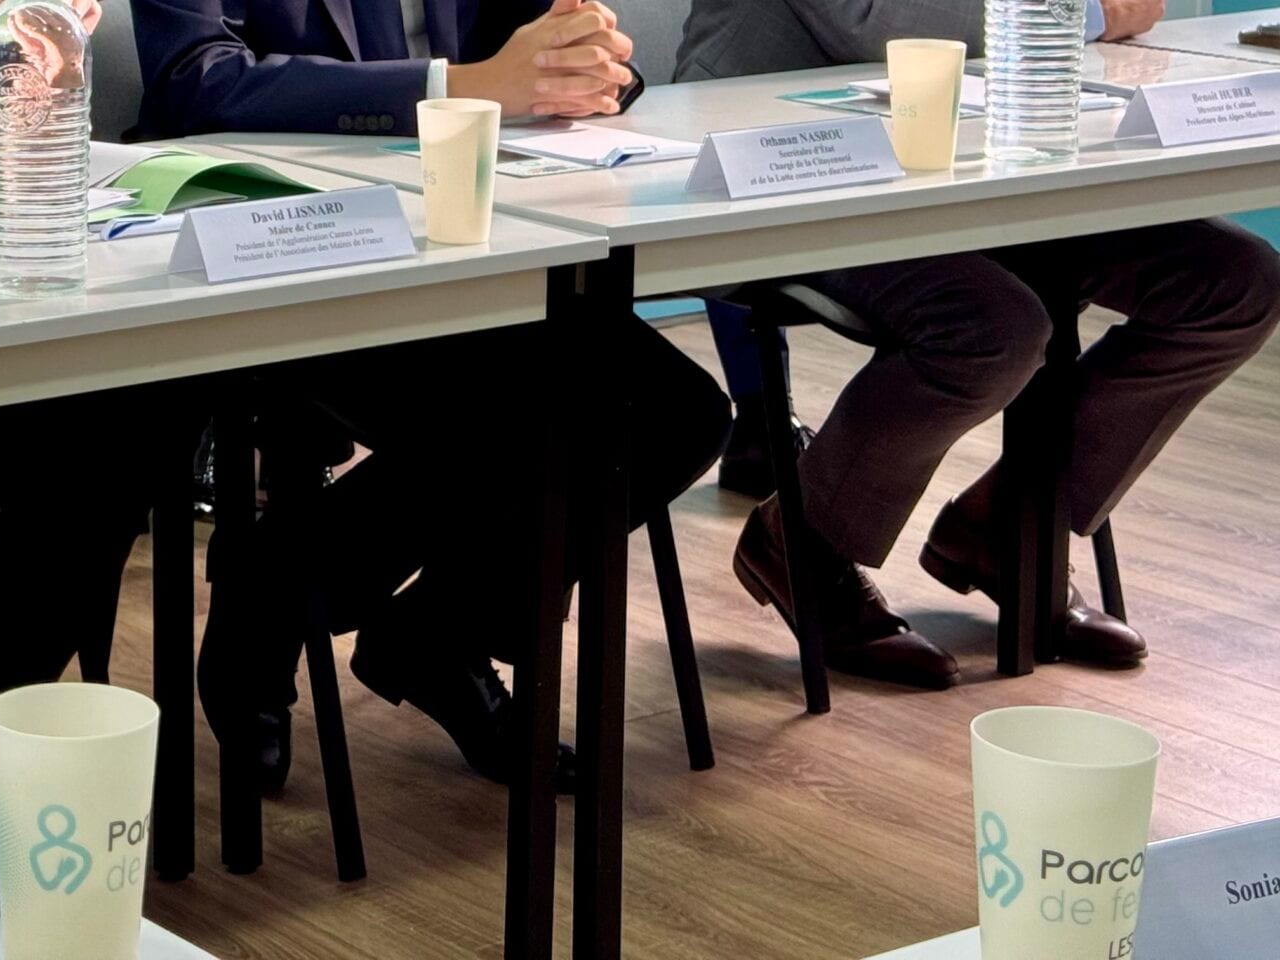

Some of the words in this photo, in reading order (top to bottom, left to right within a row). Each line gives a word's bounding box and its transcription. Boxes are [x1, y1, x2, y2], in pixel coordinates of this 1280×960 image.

[1220, 87, 1252, 100] HUBER
[1234, 101, 1257, 109] Cabinet
[1218, 113, 1227, 122] des
[1229, 110, 1276, 122] Alpes-Maritimes
[760, 135, 798, 148] Othman
[799, 128, 845, 143] NASROU
[768, 175, 775, 183] la
[775, 172, 795, 183] Lutte
[795, 171, 817, 180] contre
[828, 162, 879, 176] discriminations
[769, 162, 794, 172] Chargé
[805, 159, 812, 167] la
[252, 210, 284, 224] David
[288, 201, 344, 219] LISNARD
[268, 225, 293, 236] Maire
[295, 223, 305, 232] de
[306, 220, 336, 231] Cannes
[234, 252, 264, 263] Président
[265, 251, 273, 259] de
[274, 244, 317, 259] l'Association
[318, 243, 328, 253] des
[329, 239, 352, 250] Maires
[362, 235, 384, 246] France
[235, 241, 266, 251] Président
[267, 240, 275, 248] de
[329, 229, 352, 240] Cannes
[107, 855, 141, 892] de
[1040, 890, 1095, 925] de
